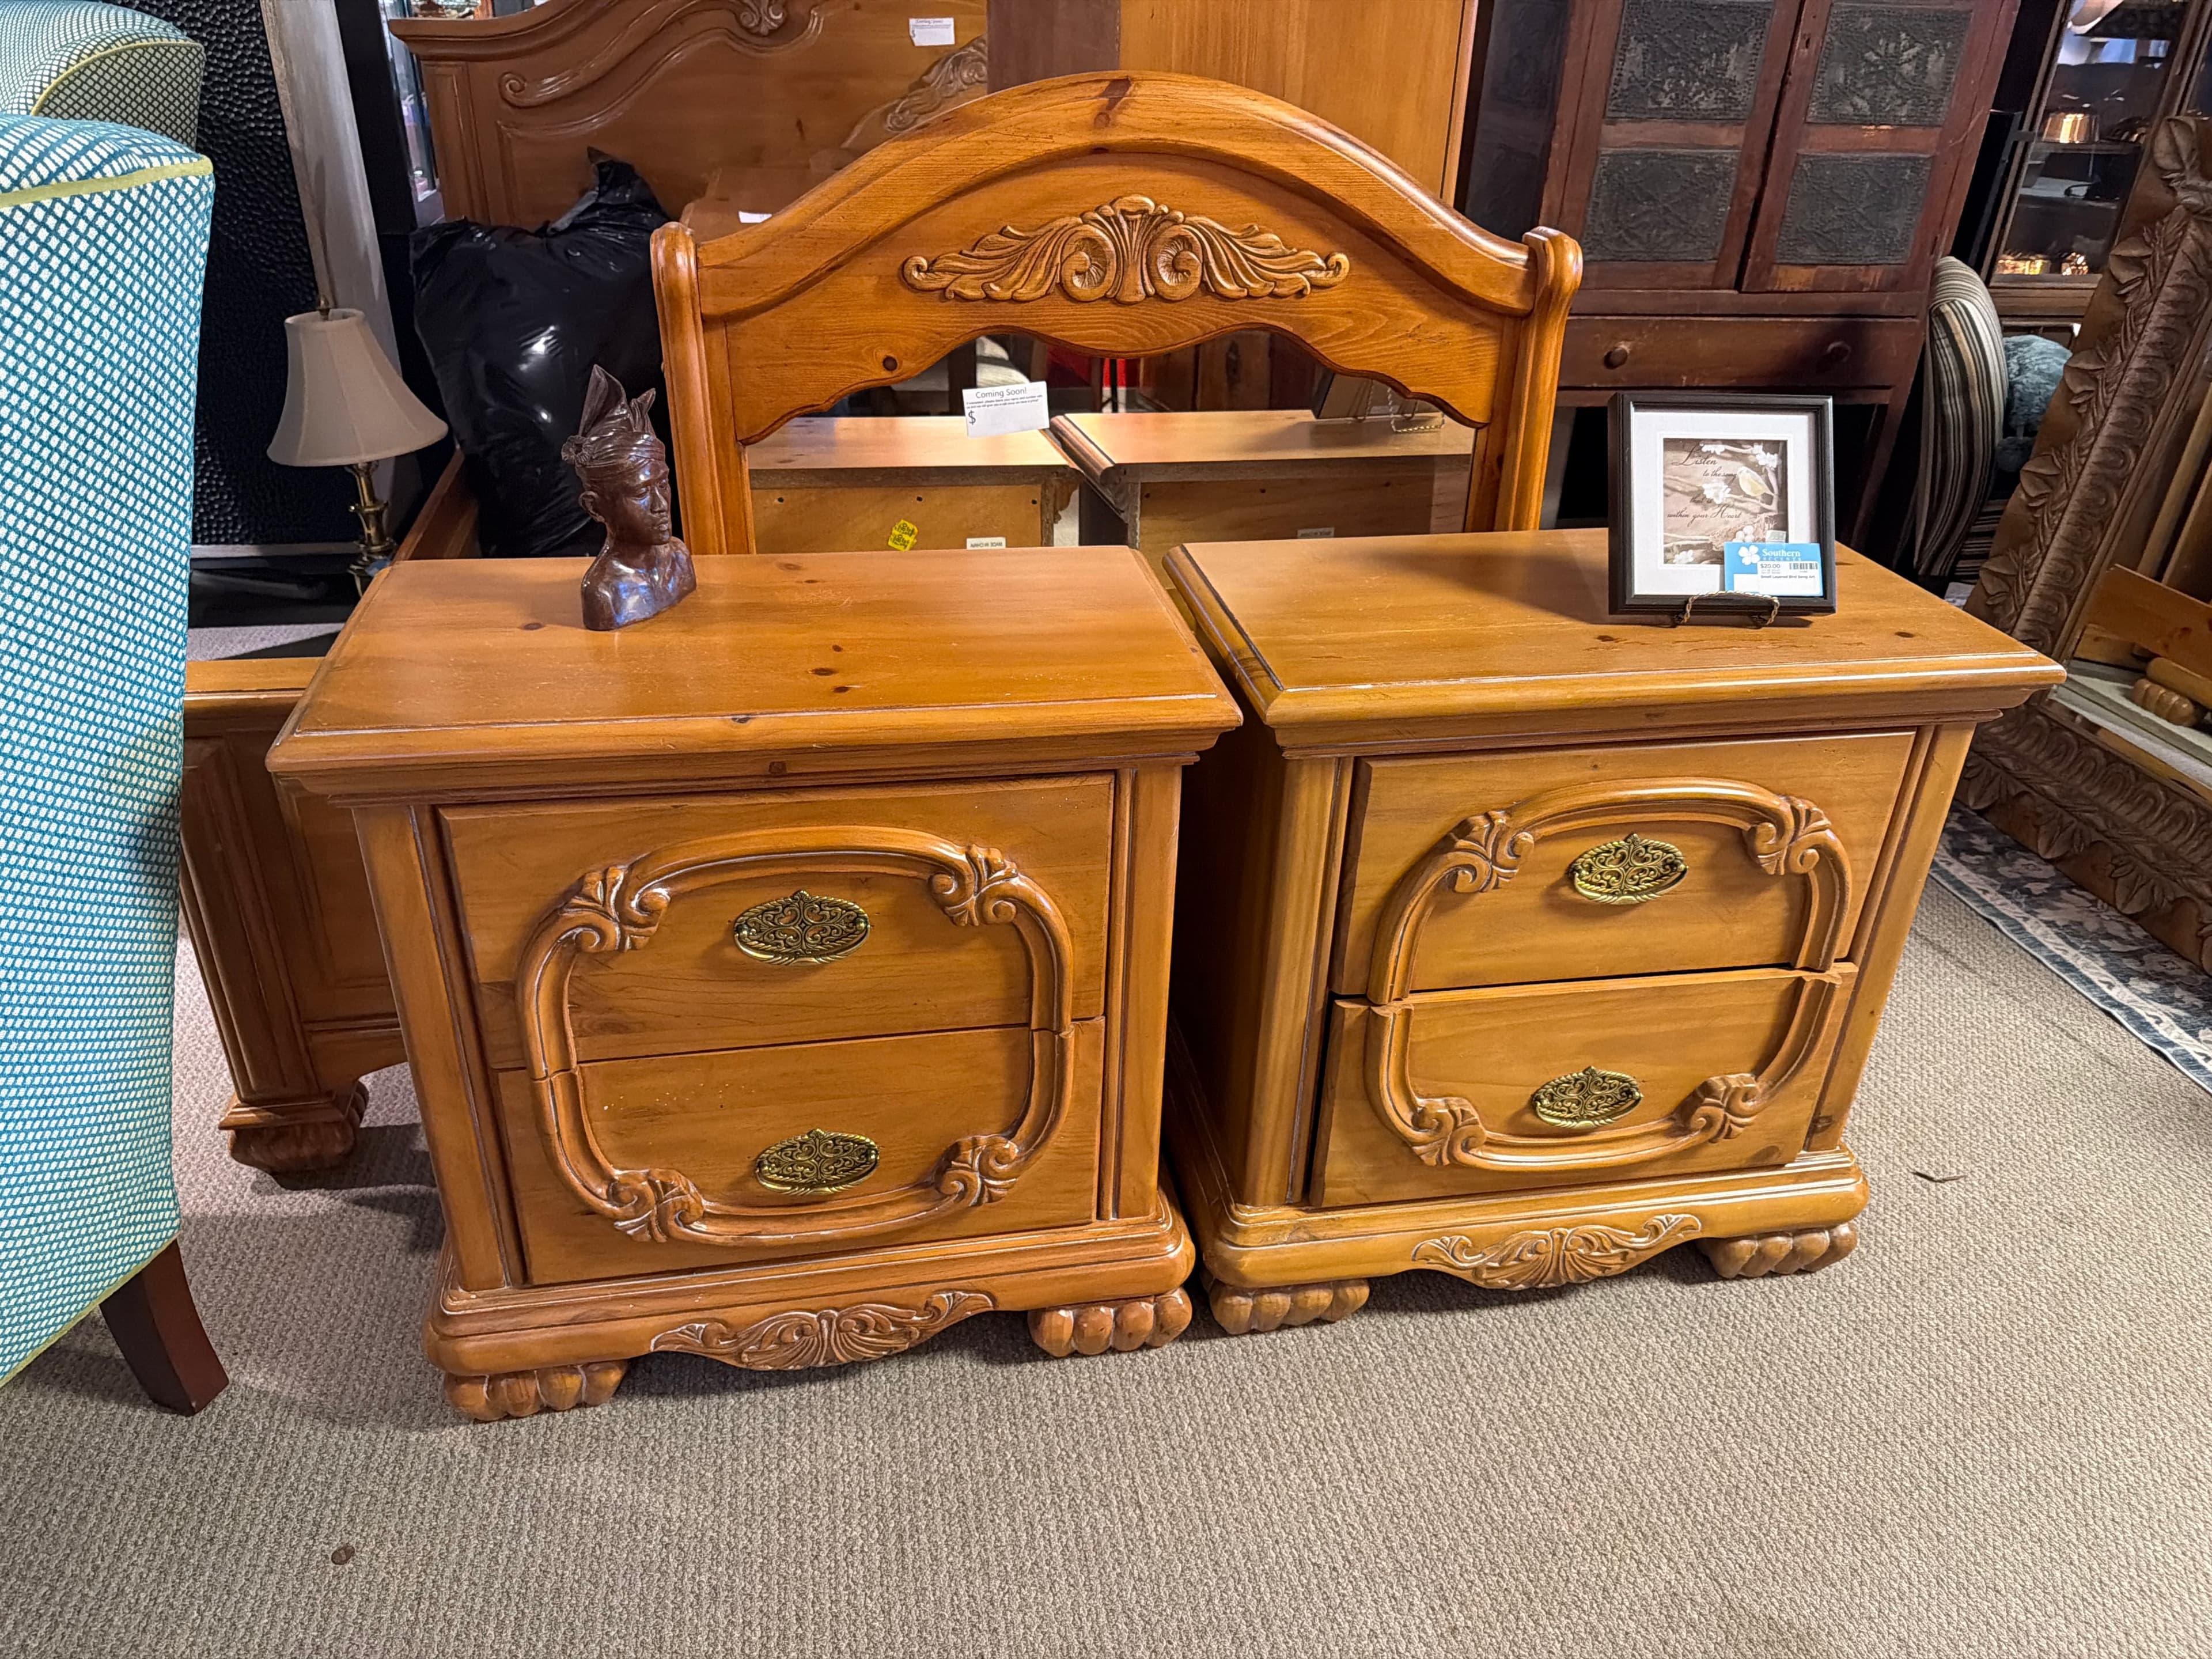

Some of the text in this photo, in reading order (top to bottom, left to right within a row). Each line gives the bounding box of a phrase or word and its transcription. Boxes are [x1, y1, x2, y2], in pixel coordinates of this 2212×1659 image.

[976, 387, 1027, 399] Coming Soon!
[968, 410, 976, 425] $
[1671, 443, 1717, 466] Listen
[1711, 466, 1721, 477] the
[1667, 507, 1689, 518] within
[1687, 514, 1707, 527] your
[1762, 548, 1801, 557] Southern
